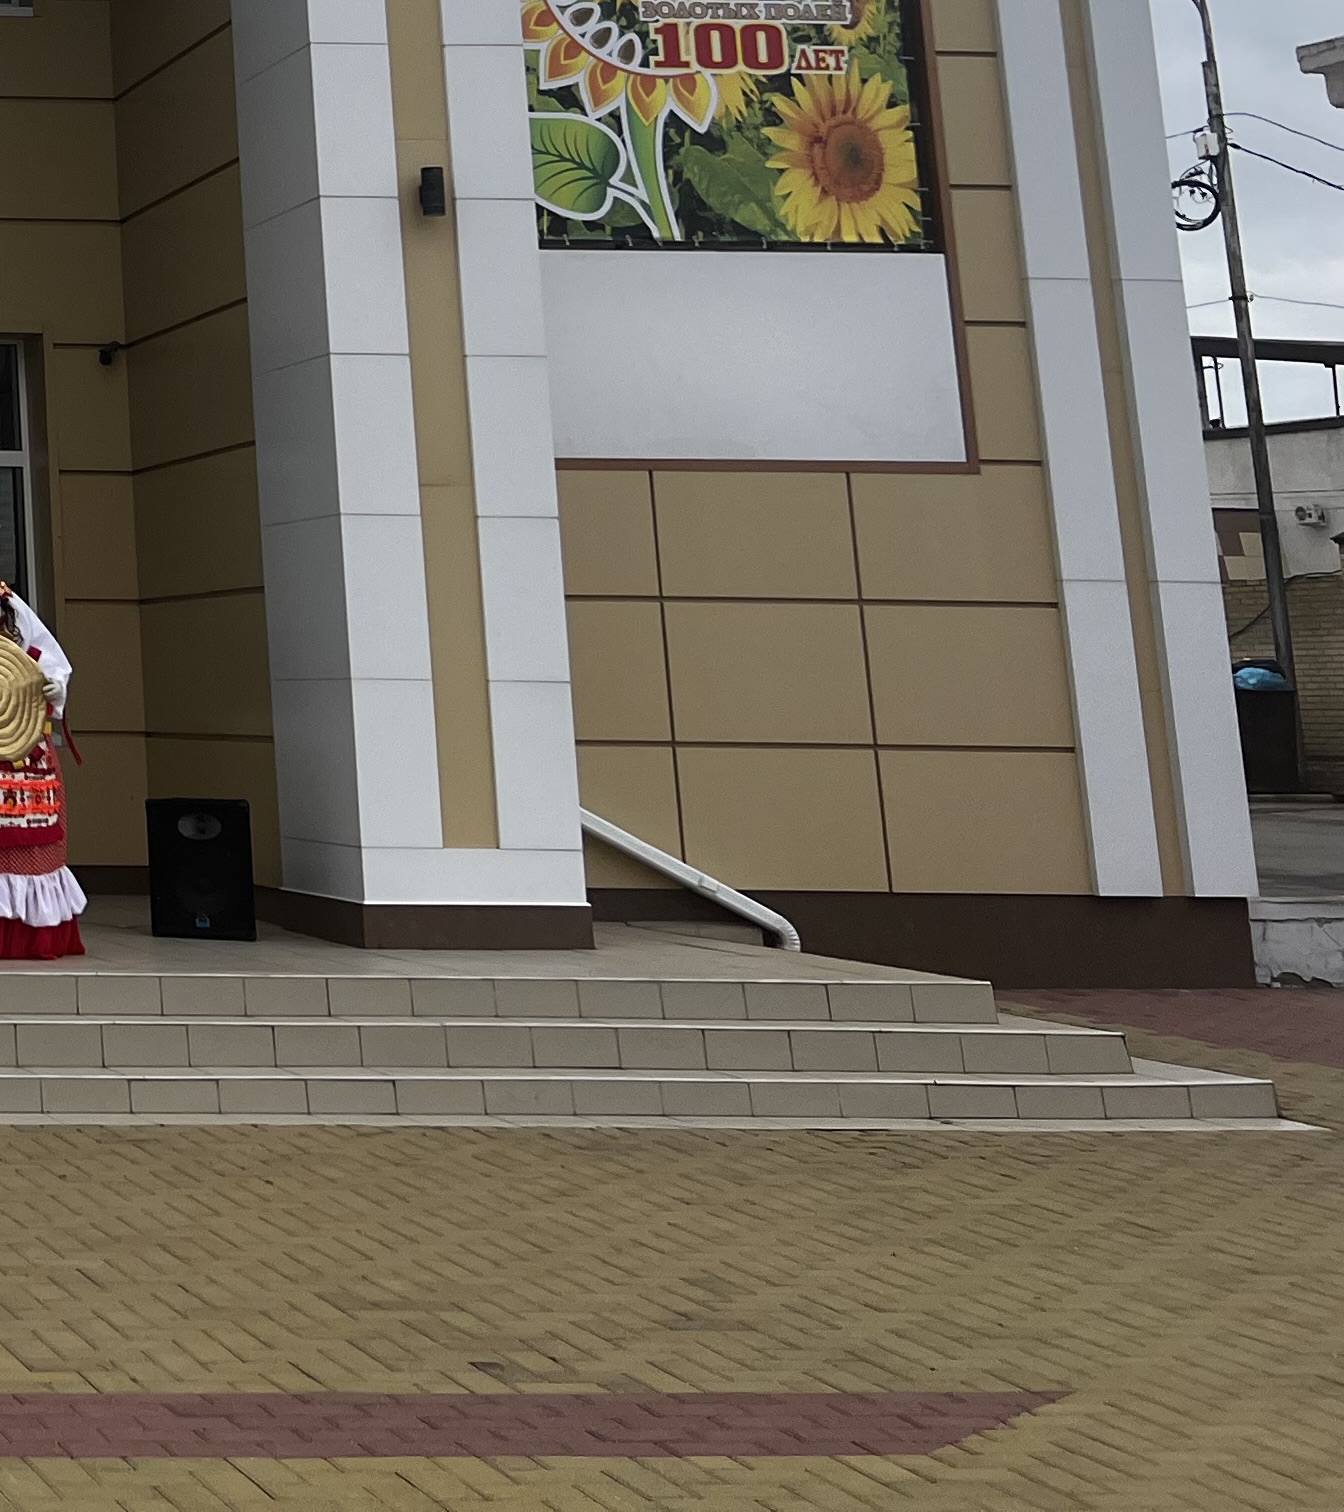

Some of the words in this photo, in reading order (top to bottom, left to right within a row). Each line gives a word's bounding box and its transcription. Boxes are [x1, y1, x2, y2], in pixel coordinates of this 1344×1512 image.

[641, 0, 760, 20] ЗОЛОТЫХ
[763, 0, 849, 21] ПОЛЕЙ
[653, 22, 785, 70] 100
[794, 48, 846, 72] ЛЕТ
